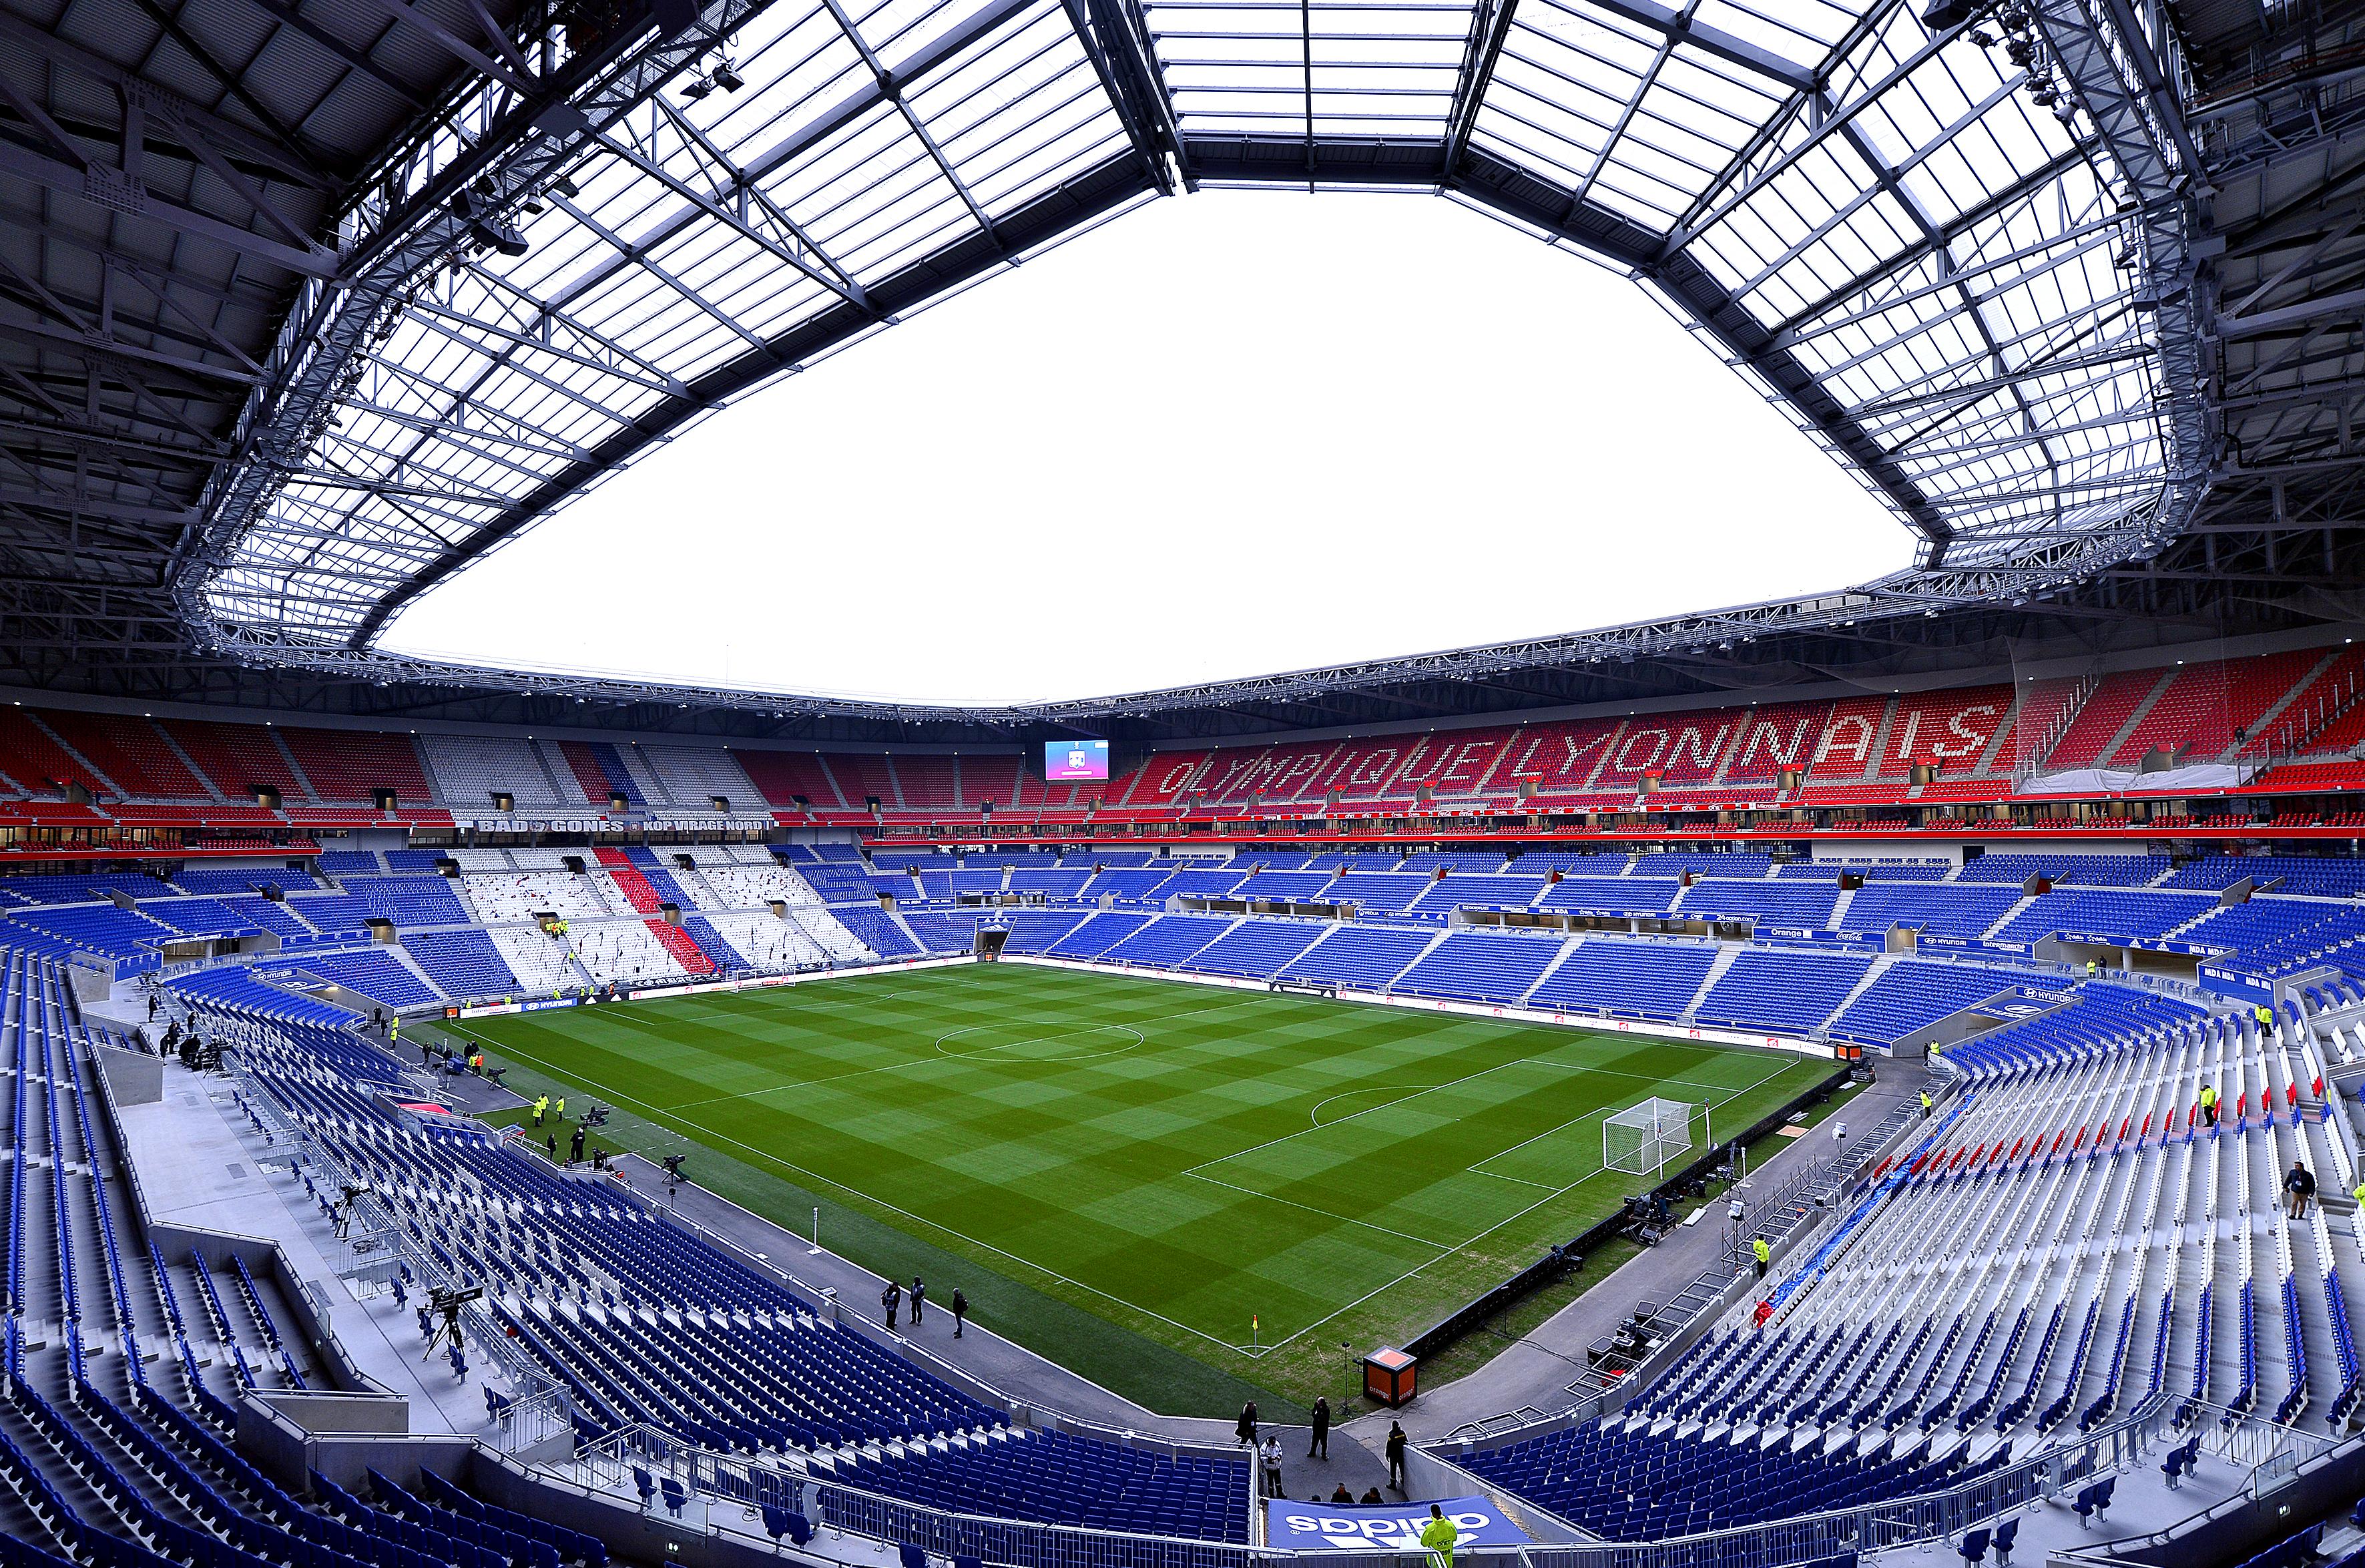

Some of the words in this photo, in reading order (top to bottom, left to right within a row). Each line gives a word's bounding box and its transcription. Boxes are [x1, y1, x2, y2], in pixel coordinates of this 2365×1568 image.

[1159, 742, 1495, 794] OLYMPIQUE
[1511, 705, 1997, 777] LYONNAIS
[478, 820, 528, 832] BAD
[551, 820, 624, 832] GONES
[643, 820, 672, 831] KOP
[674, 820, 726, 831] VIRAGE
[726, 820, 762, 830] NORD
[1771, 929, 1802, 938] Orange
[2189, 945, 2205, 954] MDA
[2207, 948, 2223, 956] MDA
[267, 970, 292, 979] HYUNDAI
[2204, 968, 2221, 978] MDA
[2221, 971, 2235, 982] MDA
[2246, 977, 2260, 988] MDA
[540, 1000, 573, 1009] HYUNDAI
[1369, 1386, 1389, 1399] orange
[1398, 1388, 1413, 1400] orange
[1436, 1539, 1451, 1547] ONET
